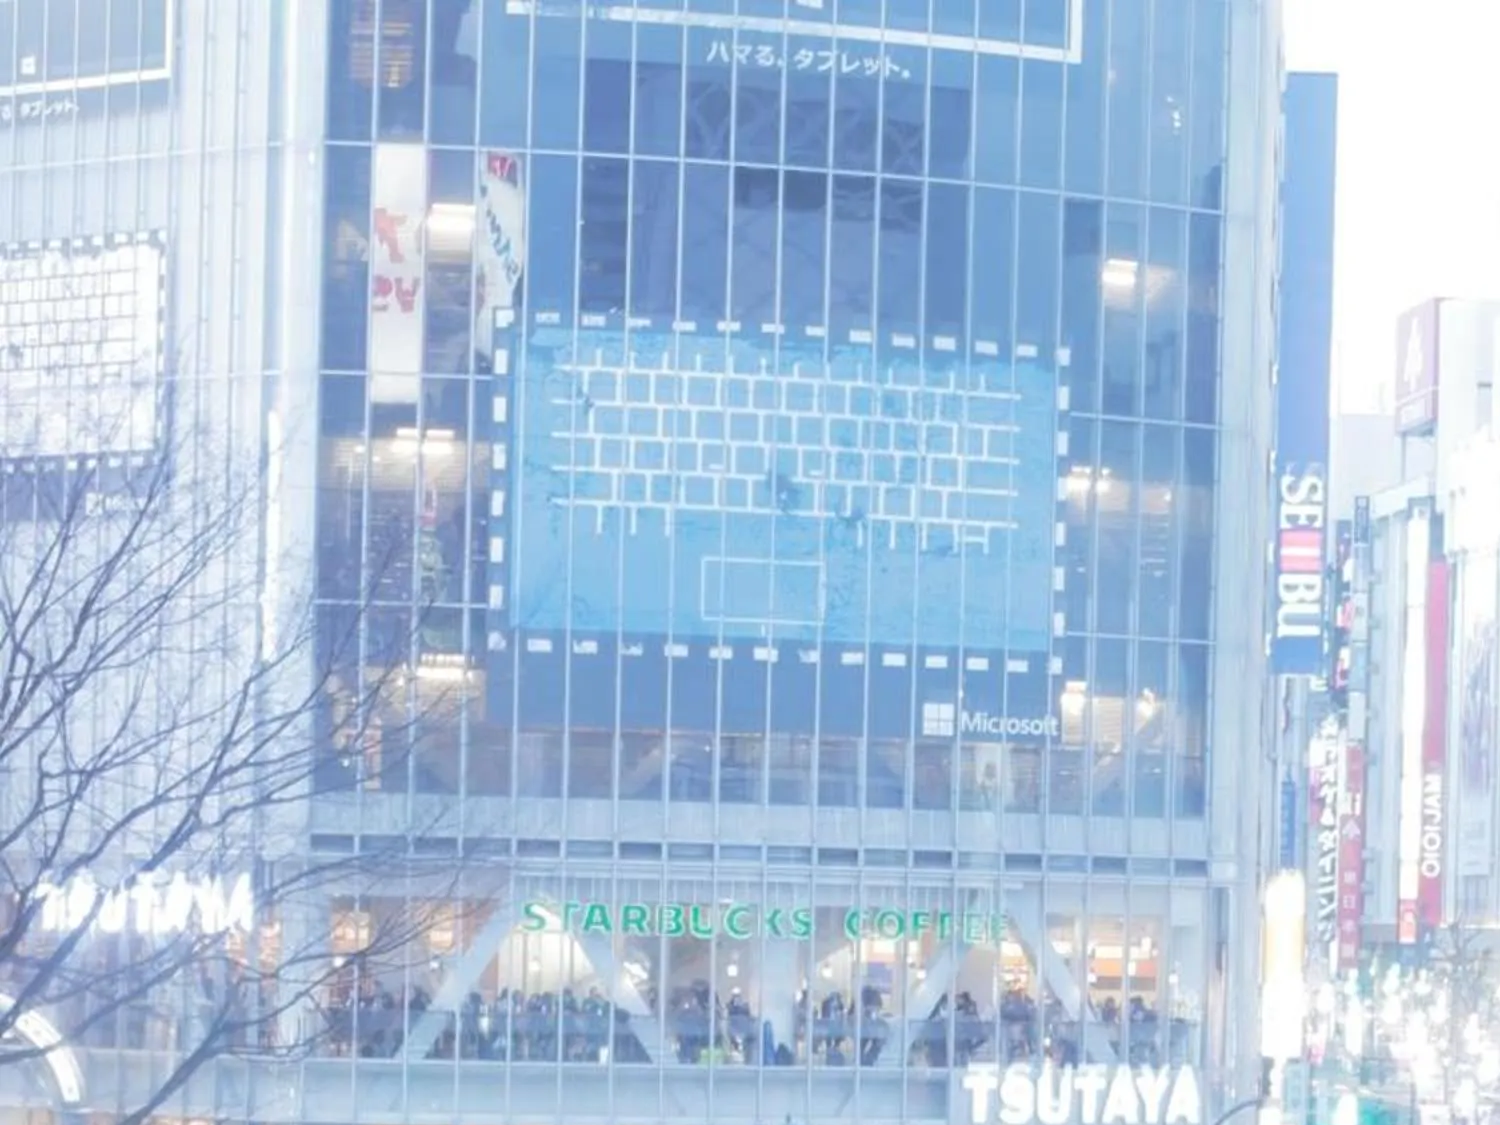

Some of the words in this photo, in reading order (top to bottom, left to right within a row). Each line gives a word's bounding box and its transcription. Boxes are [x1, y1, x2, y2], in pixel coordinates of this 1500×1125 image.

[706, 40, 911, 79] ハマる、タブレット。
[1277, 474, 1323, 638] SEIBU
[960, 710, 1059, 737] Microsoft
[522, 900, 814, 939] STARBUCKS
[845, 907, 1011, 942] COFFEE
[963, 1061, 1202, 1125] TSUTAYA
